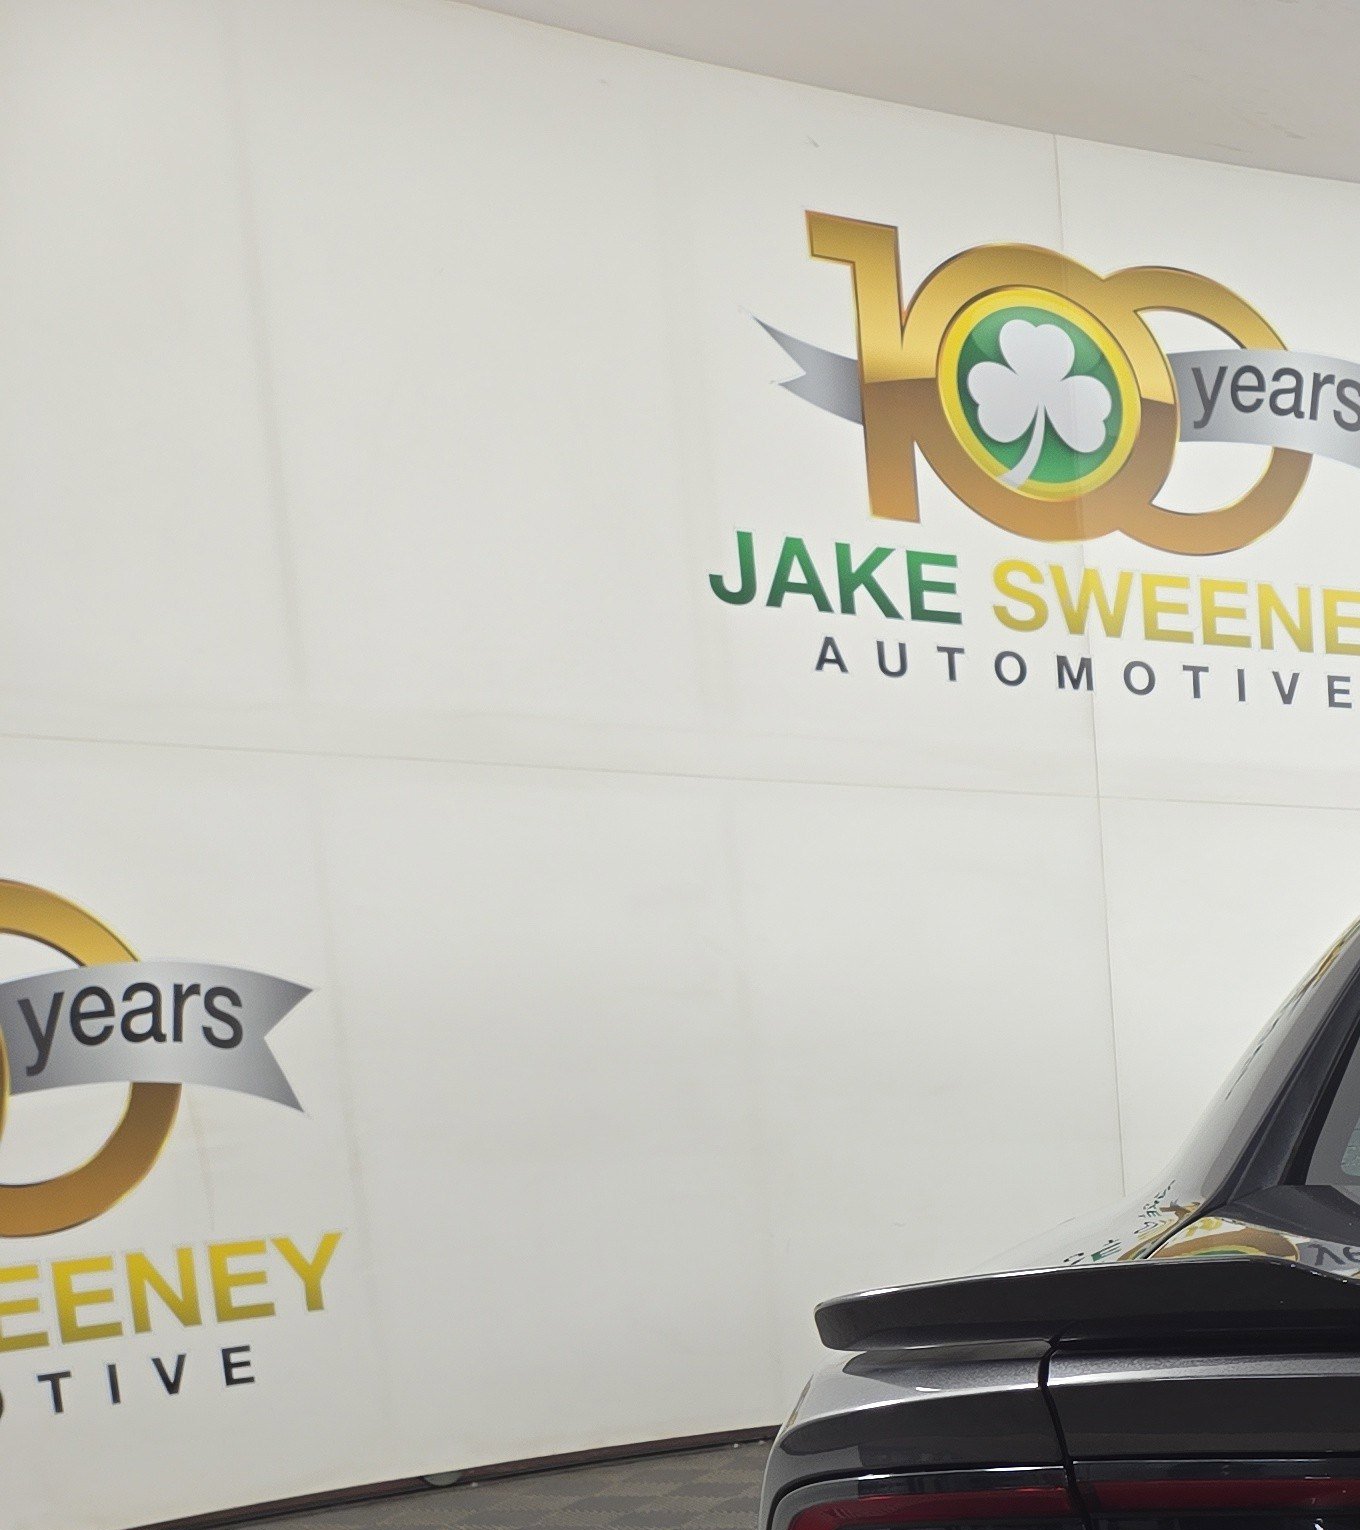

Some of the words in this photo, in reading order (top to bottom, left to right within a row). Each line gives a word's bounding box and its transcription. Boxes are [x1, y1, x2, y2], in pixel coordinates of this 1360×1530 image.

[805, 209, 1314, 556] 100
[708, 529, 963, 625] JAKE
[815, 636, 1354, 709] AUTOMOTIVE
[17, 982, 244, 1076] years
[0, 1345, 255, 1420] TIVE
